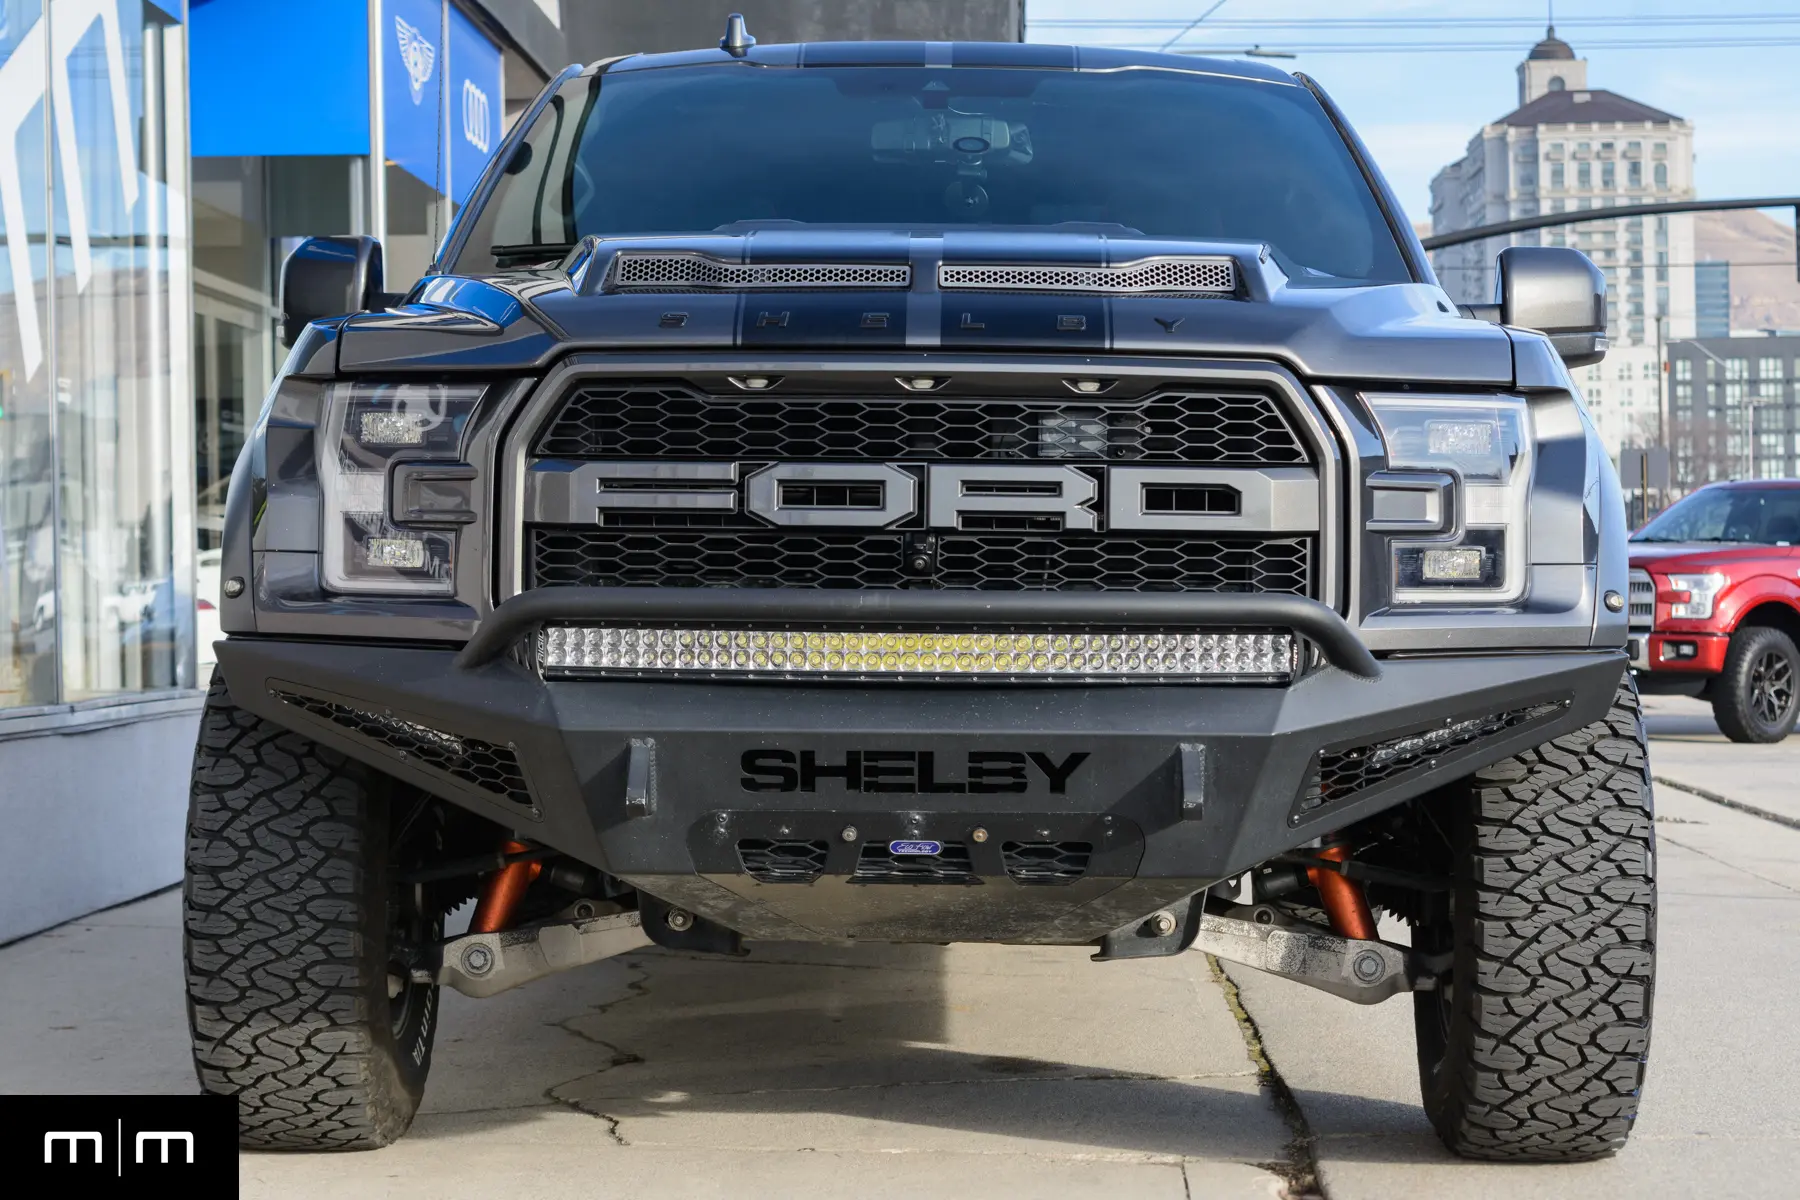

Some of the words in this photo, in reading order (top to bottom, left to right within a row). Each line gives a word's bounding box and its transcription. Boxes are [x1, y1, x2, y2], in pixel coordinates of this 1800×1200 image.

[658, 311, 1186, 333] SHELBY
[526, 461, 1319, 531] FORD
[740, 750, 1092, 794] SHELBY
